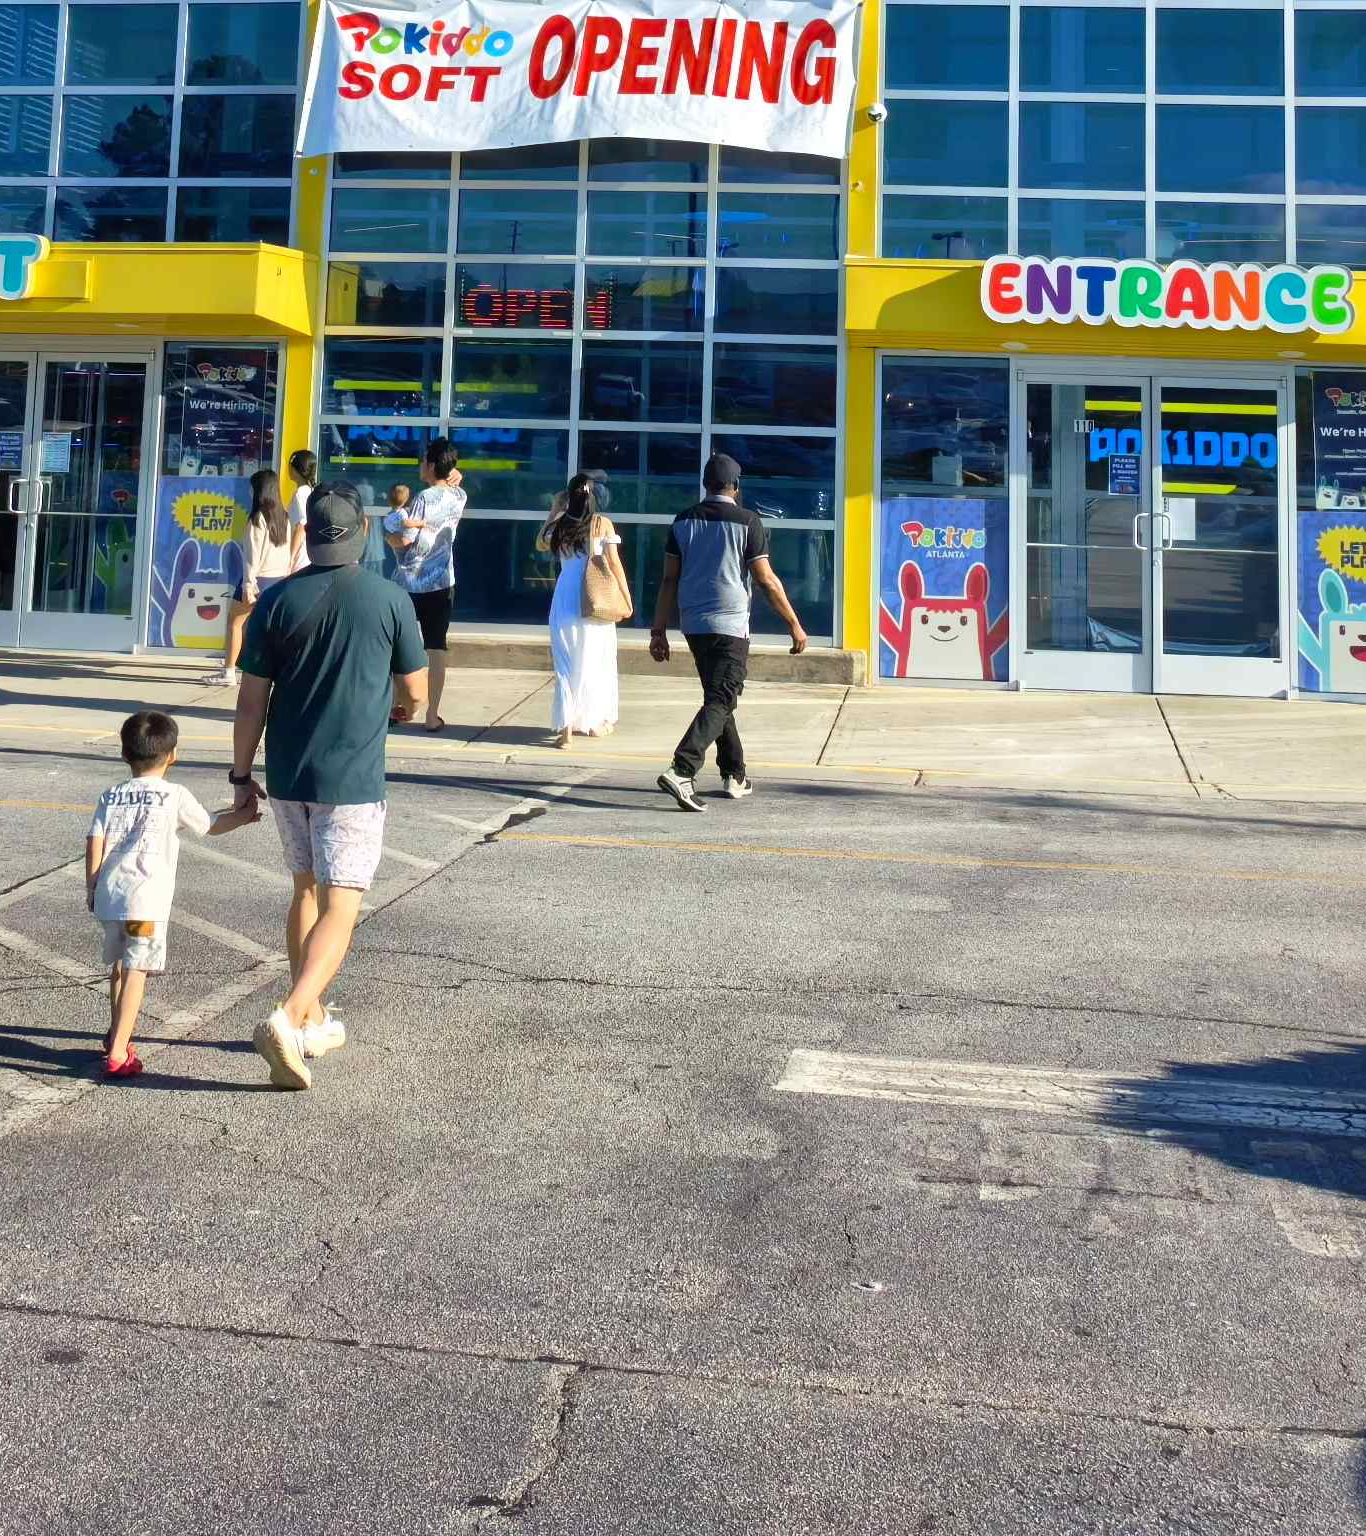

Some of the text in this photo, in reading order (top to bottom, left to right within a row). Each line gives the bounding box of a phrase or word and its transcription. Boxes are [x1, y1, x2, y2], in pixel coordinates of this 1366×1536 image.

[528, 13, 837, 106] OPENING
[337, 60, 502, 103] SOFT
[986, 259, 1349, 328] ENTRANCE
[463, 282, 610, 329] OPEN
[1074, 419, 1095, 433] 110
[1320, 426, 1356, 437] We're
[192, 504, 235, 517] LET'S
[192, 517, 232, 531] PLAY!
[925, 549, 965, 559] ATLANTA
[105, 790, 170, 806] BLUEY
